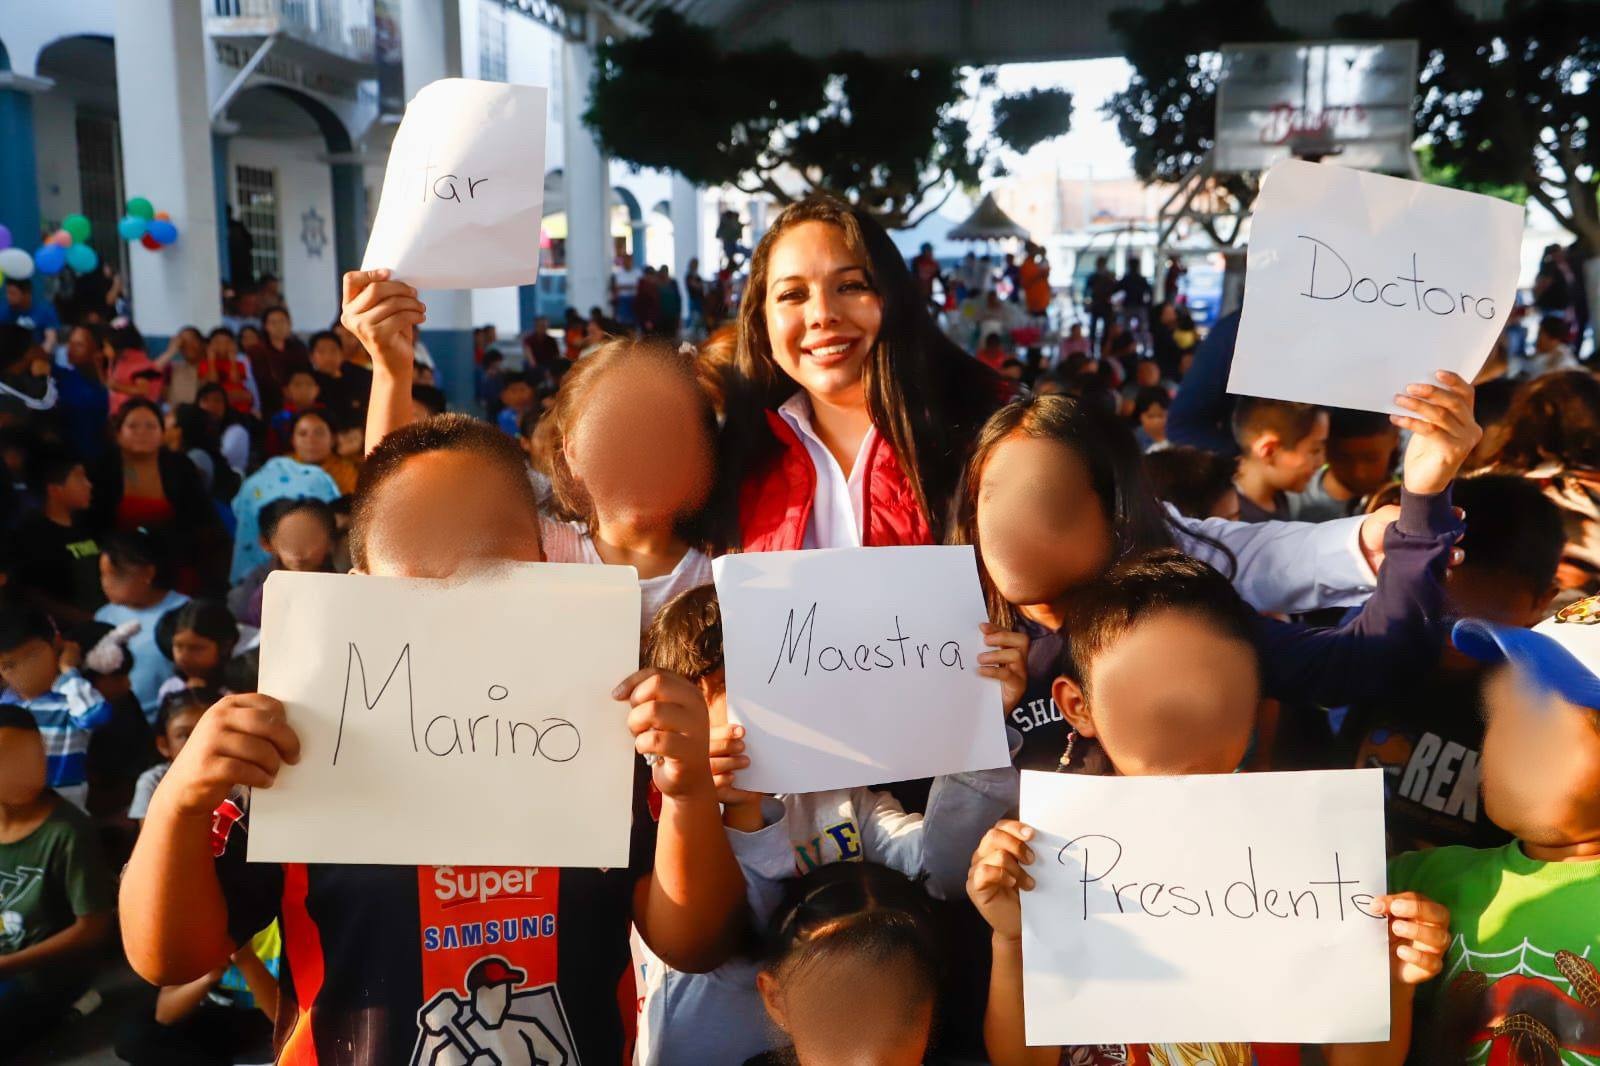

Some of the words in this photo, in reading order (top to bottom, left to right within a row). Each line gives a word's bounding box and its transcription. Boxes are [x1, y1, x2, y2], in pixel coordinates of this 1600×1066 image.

[1297, 234, 1496, 321] Doctora
[767, 601, 965, 686] Maestra
[332, 641, 582, 767] Marino
[434, 866, 540, 904] Super
[1057, 834, 1387, 923] Presidente
[423, 912, 557, 952] SAMSUNG
